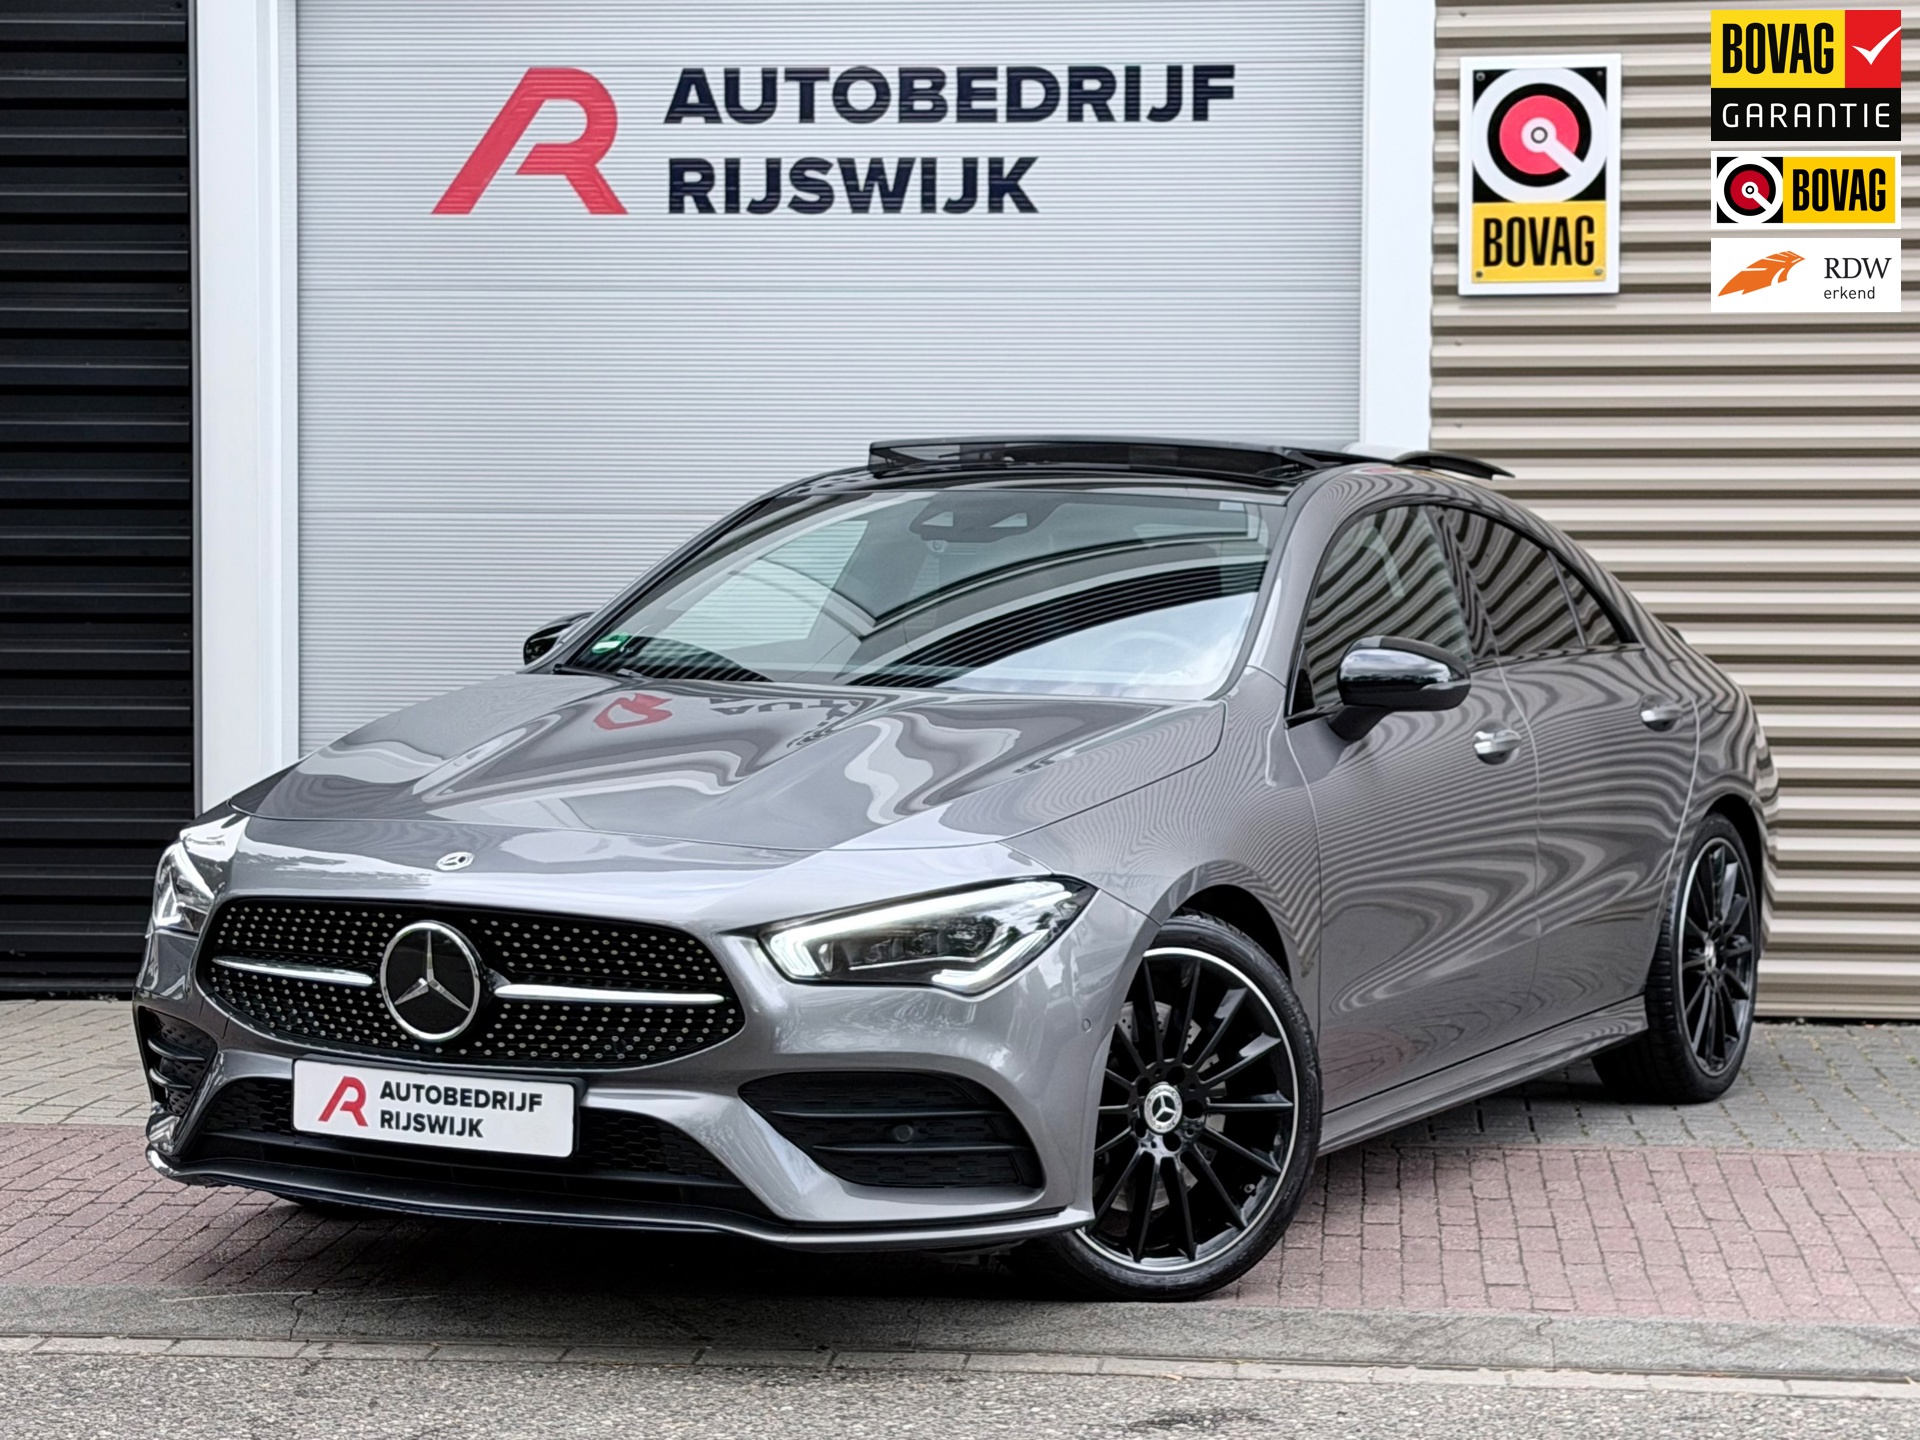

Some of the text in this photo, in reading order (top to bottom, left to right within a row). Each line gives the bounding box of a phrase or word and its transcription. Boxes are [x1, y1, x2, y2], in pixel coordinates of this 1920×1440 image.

[663, 64, 1236, 125] AUTOBEDRIJF
[667, 156, 1039, 215] RIJSWIJK
[1483, 215, 1595, 267] BOVAG
[379, 1080, 543, 1113] AUTOBEDRIJF
[379, 1109, 484, 1138] RIJSWIJK
